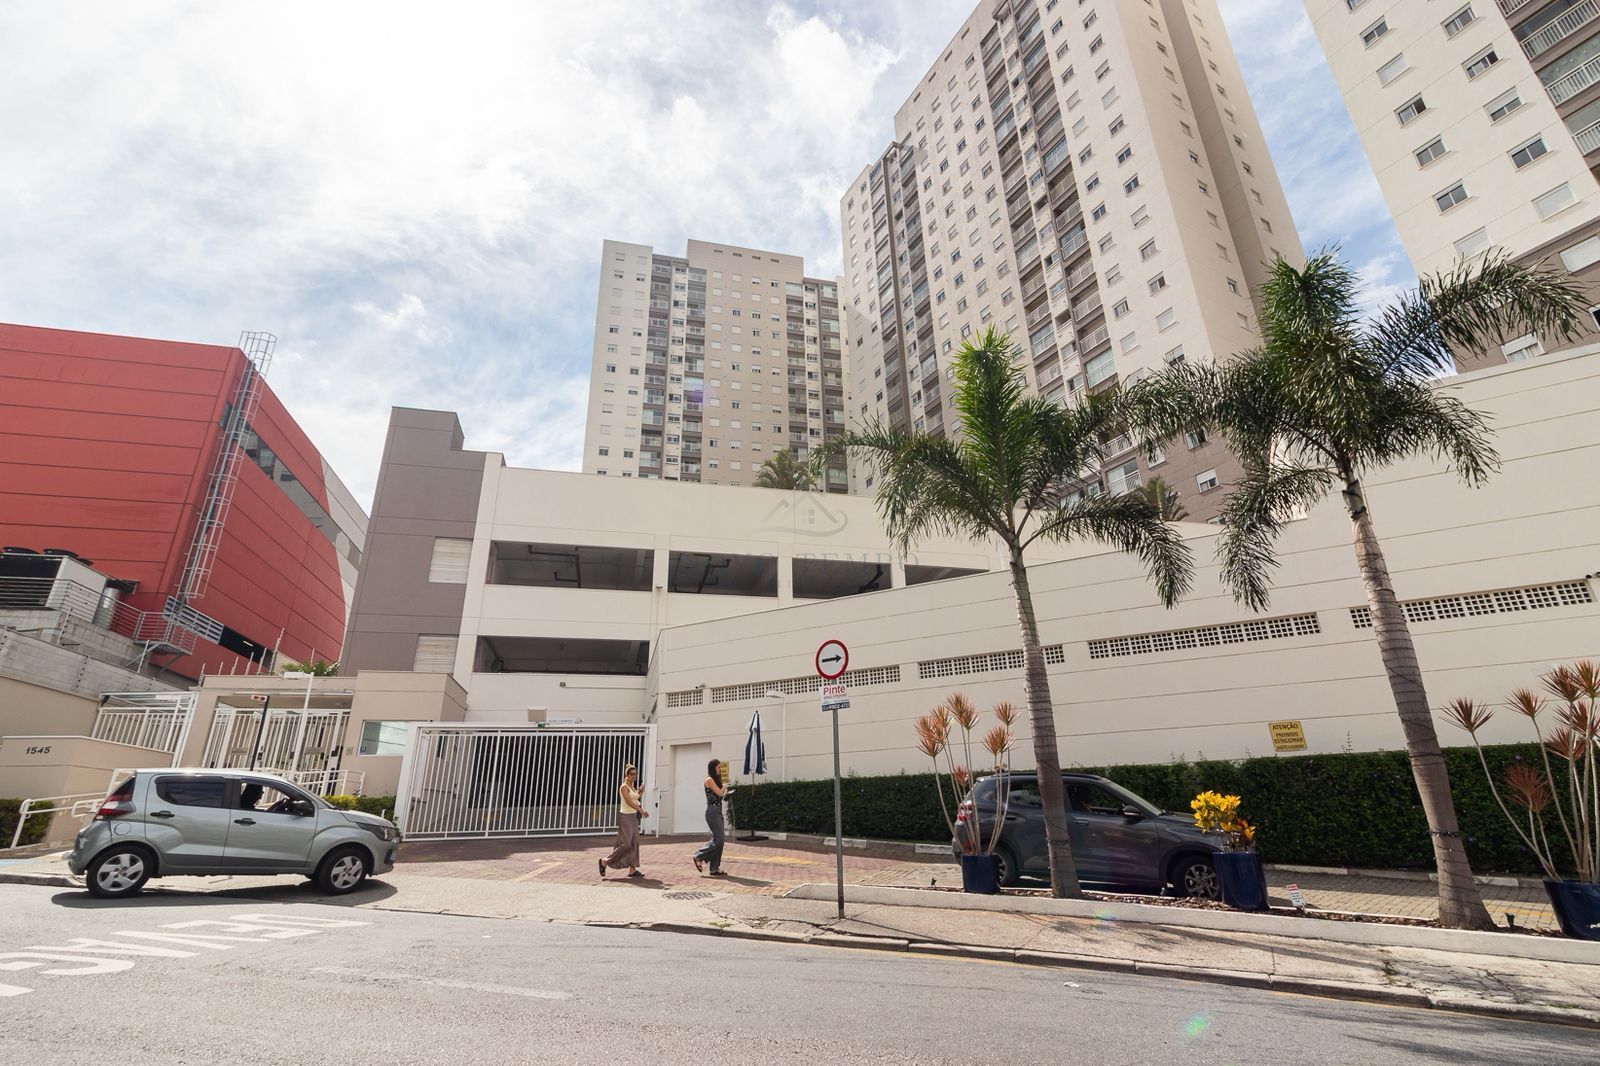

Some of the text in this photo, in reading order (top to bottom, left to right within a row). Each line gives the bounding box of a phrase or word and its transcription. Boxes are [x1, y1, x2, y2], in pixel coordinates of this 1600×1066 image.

[823, 685, 846, 695] Pinte
[1272, 722, 1299, 730] ATENÇÃO
[26, 746, 52, 754] 1545
[0, 913, 374, 997] DEVAG
